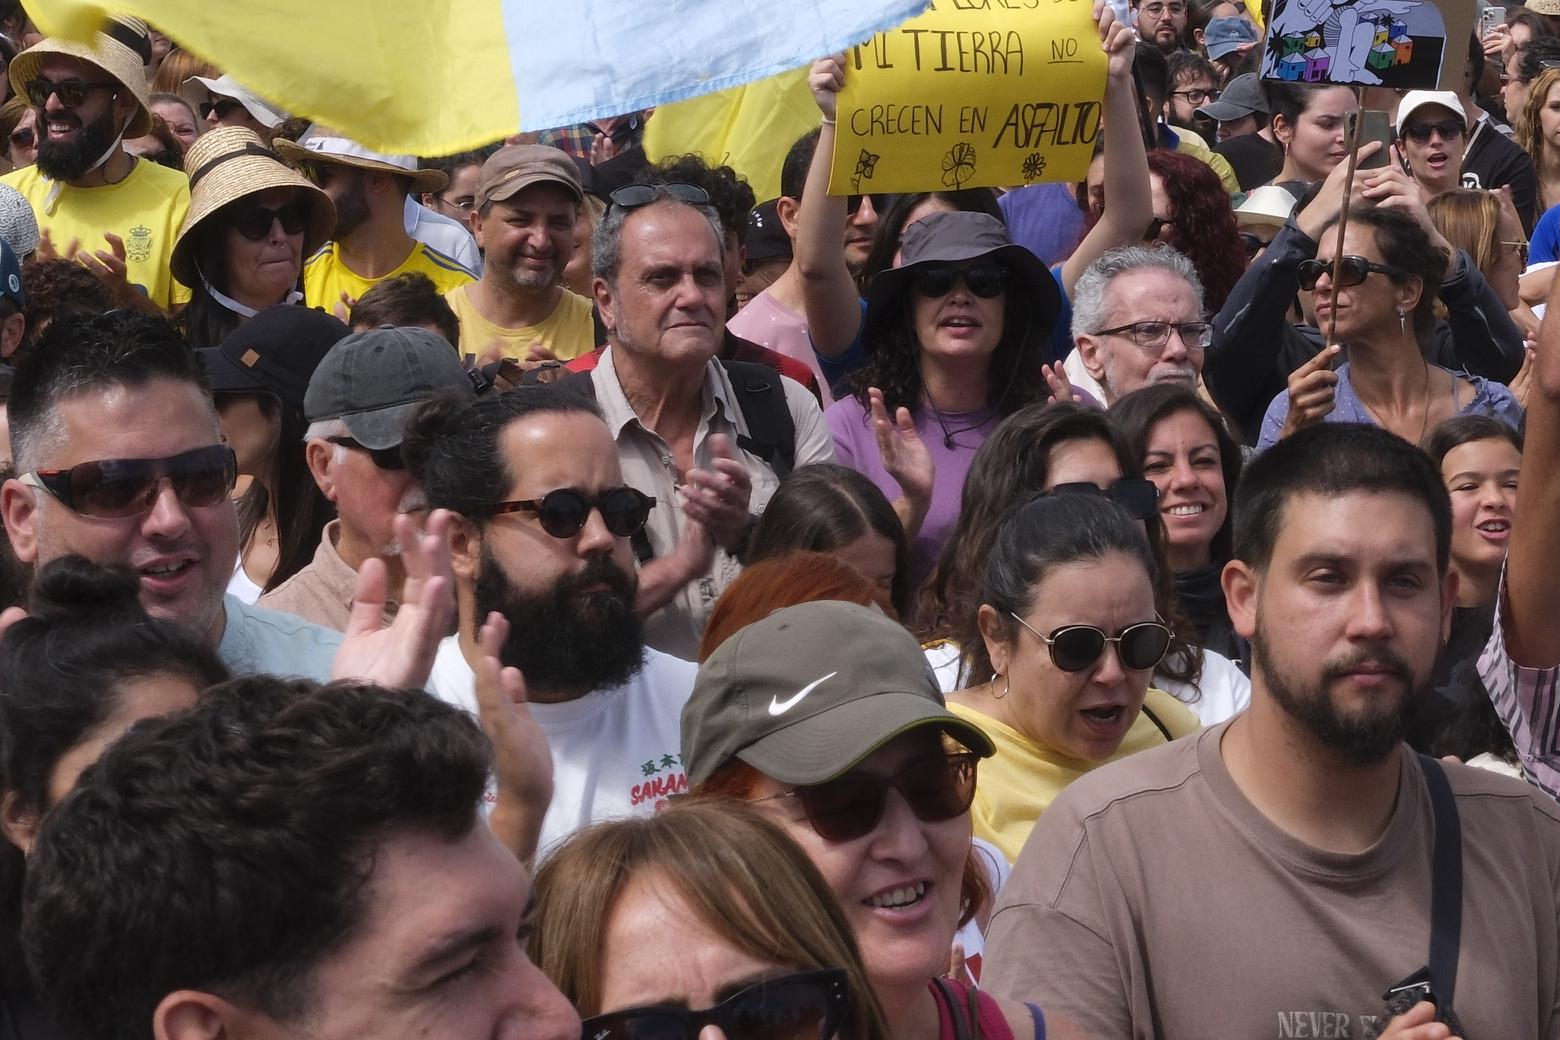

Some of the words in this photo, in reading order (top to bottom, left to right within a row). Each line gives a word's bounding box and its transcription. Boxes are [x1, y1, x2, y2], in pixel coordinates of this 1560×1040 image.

[853, 32, 893, 71] MI
[902, 29, 1024, 76] TIERRA
[1051, 38, 1078, 61] NO
[851, 104, 943, 136] CRECEN
[960, 106, 989, 134] EN
[992, 101, 1102, 149] ASFALTO
[1278, 1011, 1351, 1039] NEVER
